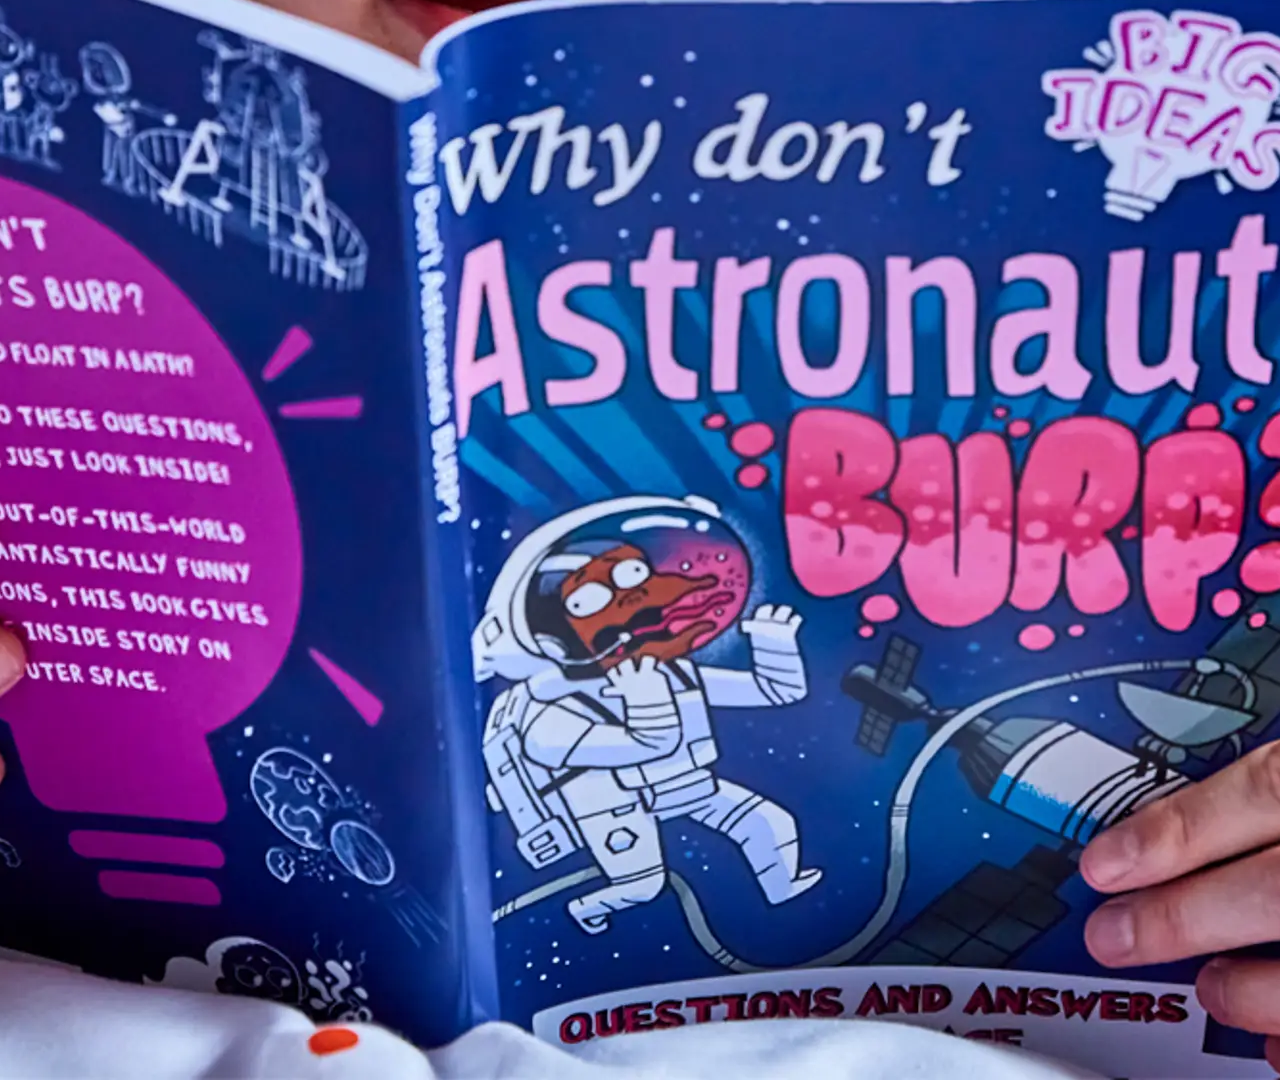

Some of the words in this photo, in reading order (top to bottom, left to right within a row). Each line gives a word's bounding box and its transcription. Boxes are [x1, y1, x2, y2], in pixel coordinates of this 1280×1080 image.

[438, 105, 661, 216] Why
[692, 92, 972, 187] don't
[43, 275, 146, 316] BURP?
[10, 341, 76, 367] FLOAT
[79, 346, 111, 370] IN
[115, 349, 129, 370] A
[129, 350, 196, 378] BATH?
[16, 405, 99, 433] THESE
[101, 410, 254, 453] QUESTIONS,
[6, 445, 65, 470] JUST
[70, 450, 132, 476] LOOK
[133, 454, 232, 486] INSIDE!
[175, 555, 252, 585] FUNNY
[61, 586, 127, 611] THIS
[130, 590, 188, 619] BOOK
[190, 597, 270, 628] GIVES
[22, 621, 111, 649] INSIDE
[116, 629, 191, 658] STORY
[197, 637, 233, 662] ON
[25, 661, 85, 685] UTER
[90, 664, 168, 694] SPACE.
[558, 986, 845, 1045] QUESTIONS
[854, 981, 953, 1017] AND
[962, 981, 1190, 1024] ANSWERS
